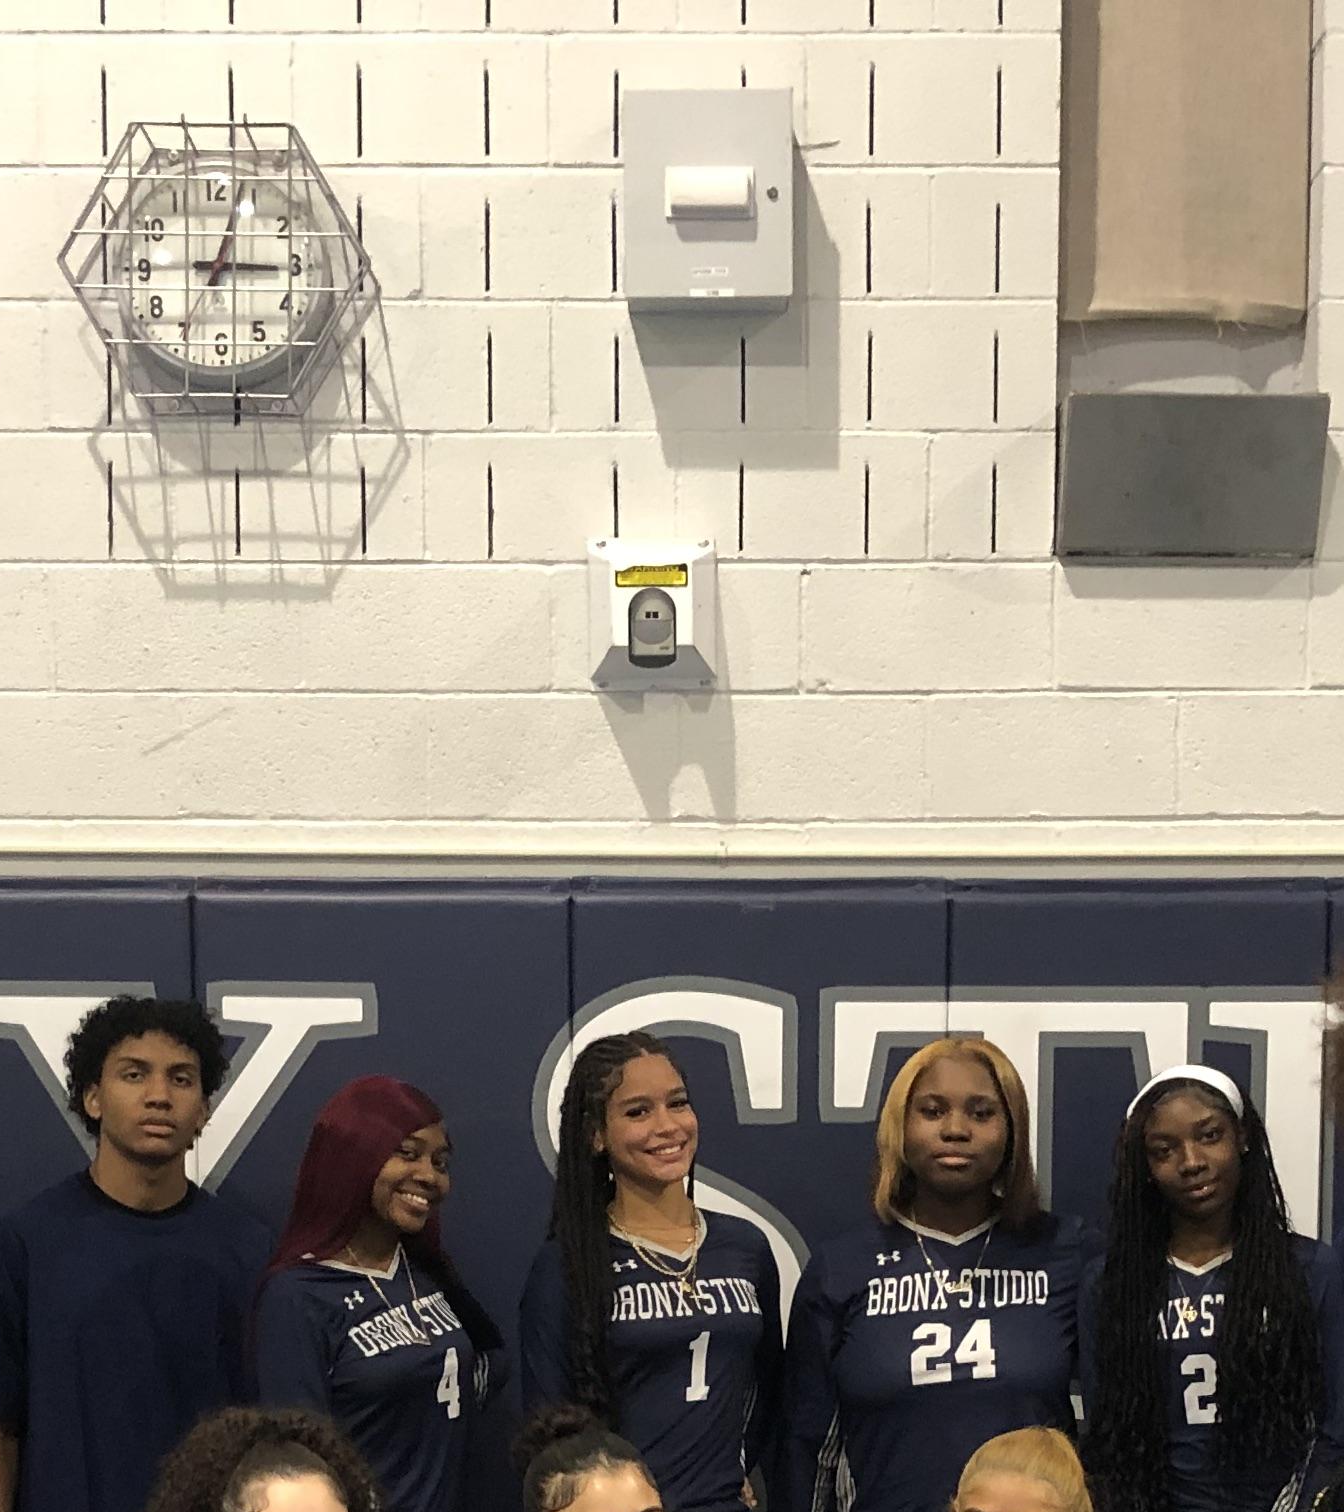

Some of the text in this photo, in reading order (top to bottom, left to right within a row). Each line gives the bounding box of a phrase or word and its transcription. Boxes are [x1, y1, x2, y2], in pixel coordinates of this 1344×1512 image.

[144, 217, 164, 242] 10
[276, 216, 290, 239] 2
[137, 258, 151, 282] 9
[290, 253, 302, 276] 3
[150, 295, 163, 318] 8
[279, 293, 294, 311] 4
[252, 320, 266, 342] 5
[214, 332, 229, 357] 6
[611, 1281, 694, 1322] RONX
[866, 1267, 1049, 1316] BRONX STUDIO
[910, 1318, 997, 1386] 24
[685, 1330, 711, 1402] 1
[436, 1346, 461, 1419] 4
[1180, 1353, 1219, 1425] 2
